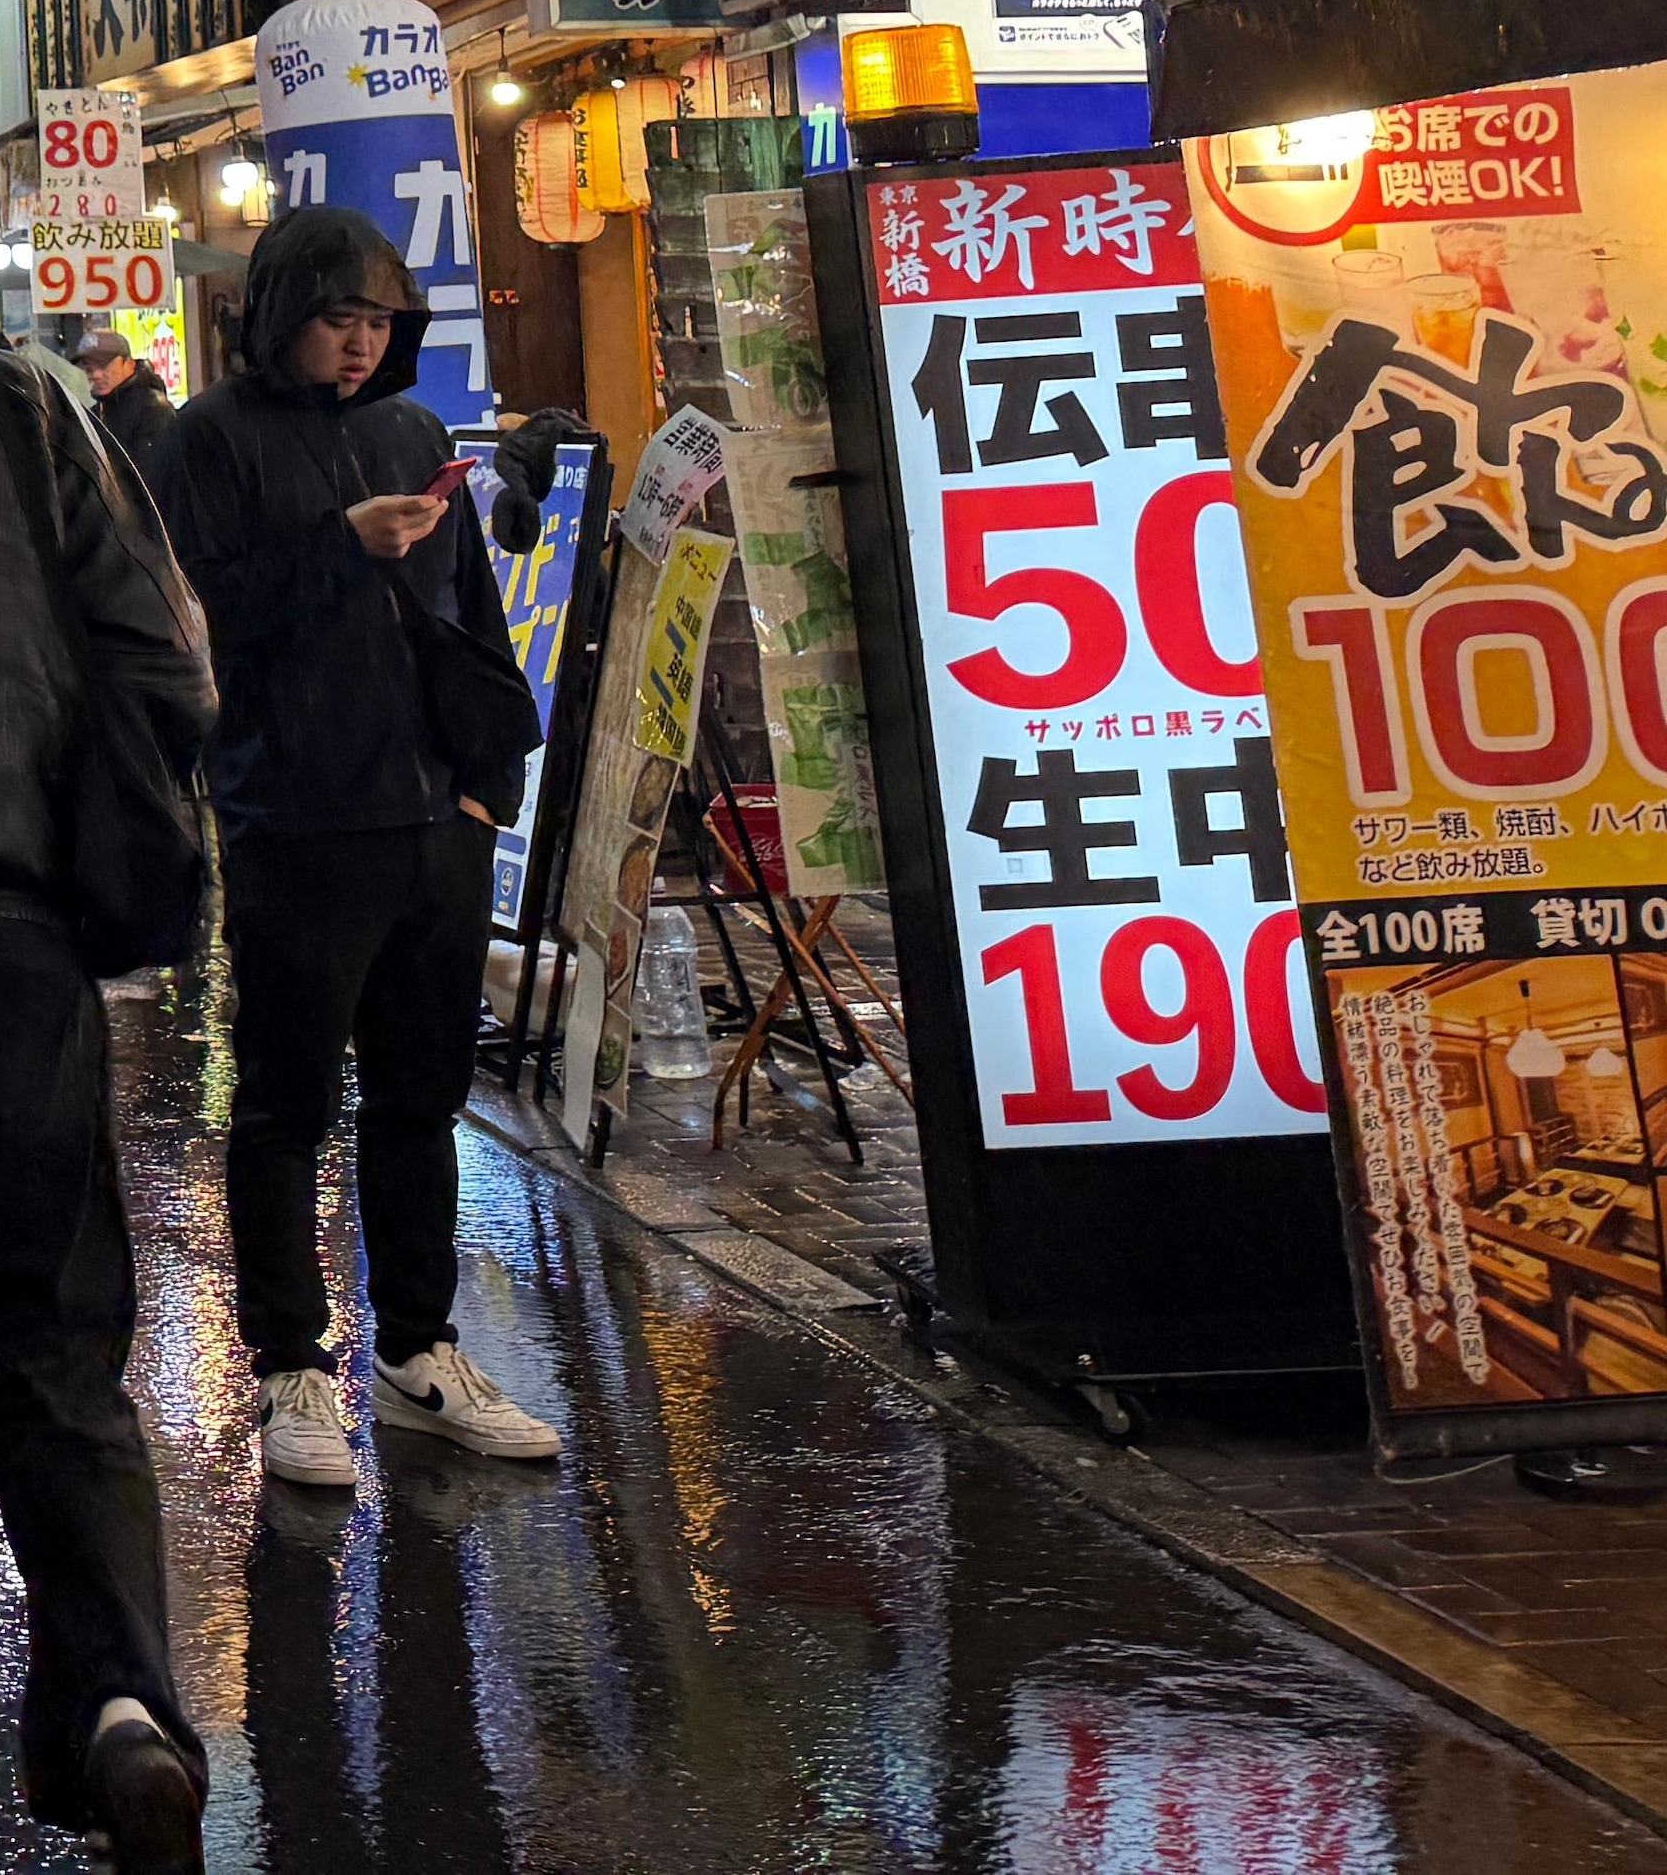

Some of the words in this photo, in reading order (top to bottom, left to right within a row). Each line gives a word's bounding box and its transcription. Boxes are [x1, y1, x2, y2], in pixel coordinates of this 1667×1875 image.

[269, 47, 310, 79] Ban
[279, 62, 325, 97] Ban
[45, 97, 110, 117] やきとん
[1371, 103, 1559, 155] お席での
[43, 119, 121, 169] 80
[48, 193, 118, 218] 280
[877, 183, 919, 208] 東京
[1379, 162, 1565, 208] 喫煙OK!
[32, 222, 164, 251] 飲み放題
[931, 166, 1197, 291] 新時
[877, 210, 932, 299] 新橋
[37, 254, 164, 309] 950
[393, 159, 495, 415] カラ
[682, 541, 717, 584] メニュー
[674, 594, 703, 642] 中国語
[667, 652, 696, 705] 英語
[1357, 847, 1548, 882] など飲み放題。
[1317, 908, 1486, 962] 全100席
[1530, 897, 1627, 949] 貸切
